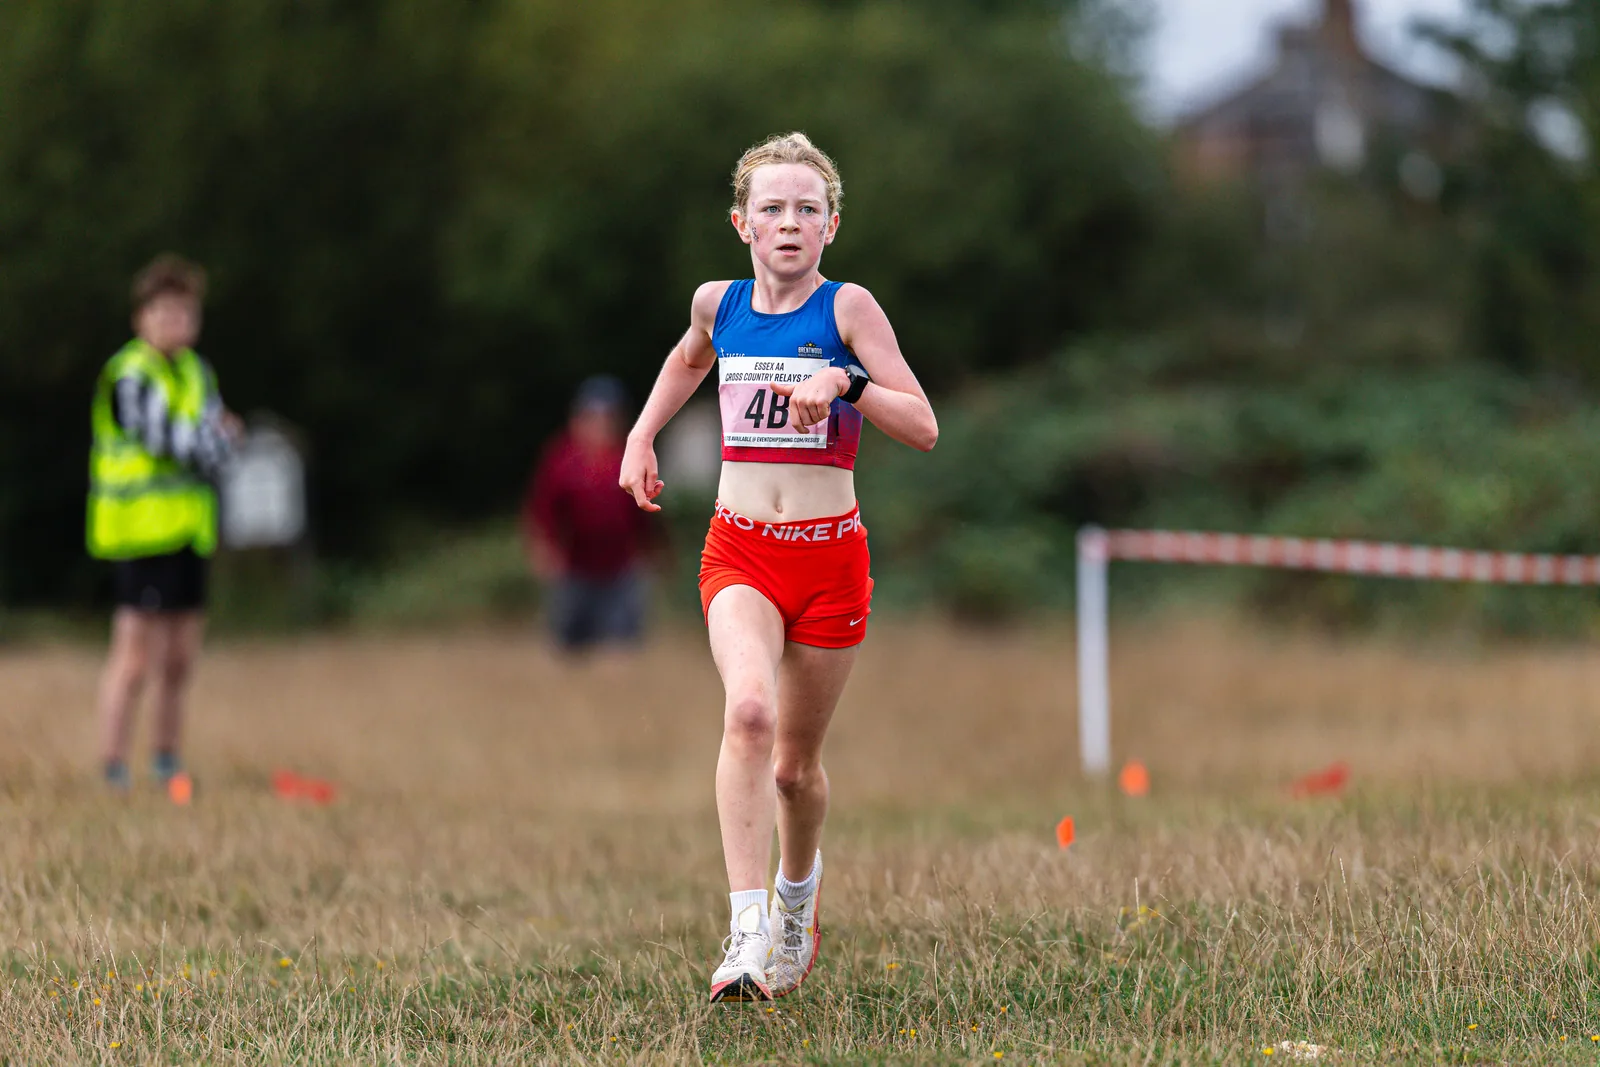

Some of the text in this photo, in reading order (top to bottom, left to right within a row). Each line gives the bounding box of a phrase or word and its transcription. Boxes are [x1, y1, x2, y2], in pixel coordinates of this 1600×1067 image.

[754, 362, 785, 371] ESSEX AA
[725, 373, 743, 382] CROSS
[743, 373, 774, 382] COUNTRY
[774, 373, 802, 383] RELAYS
[744, 388, 790, 429] 4B
[761, 522, 833, 542] NIKE
[836, 510, 861, 539] PR
